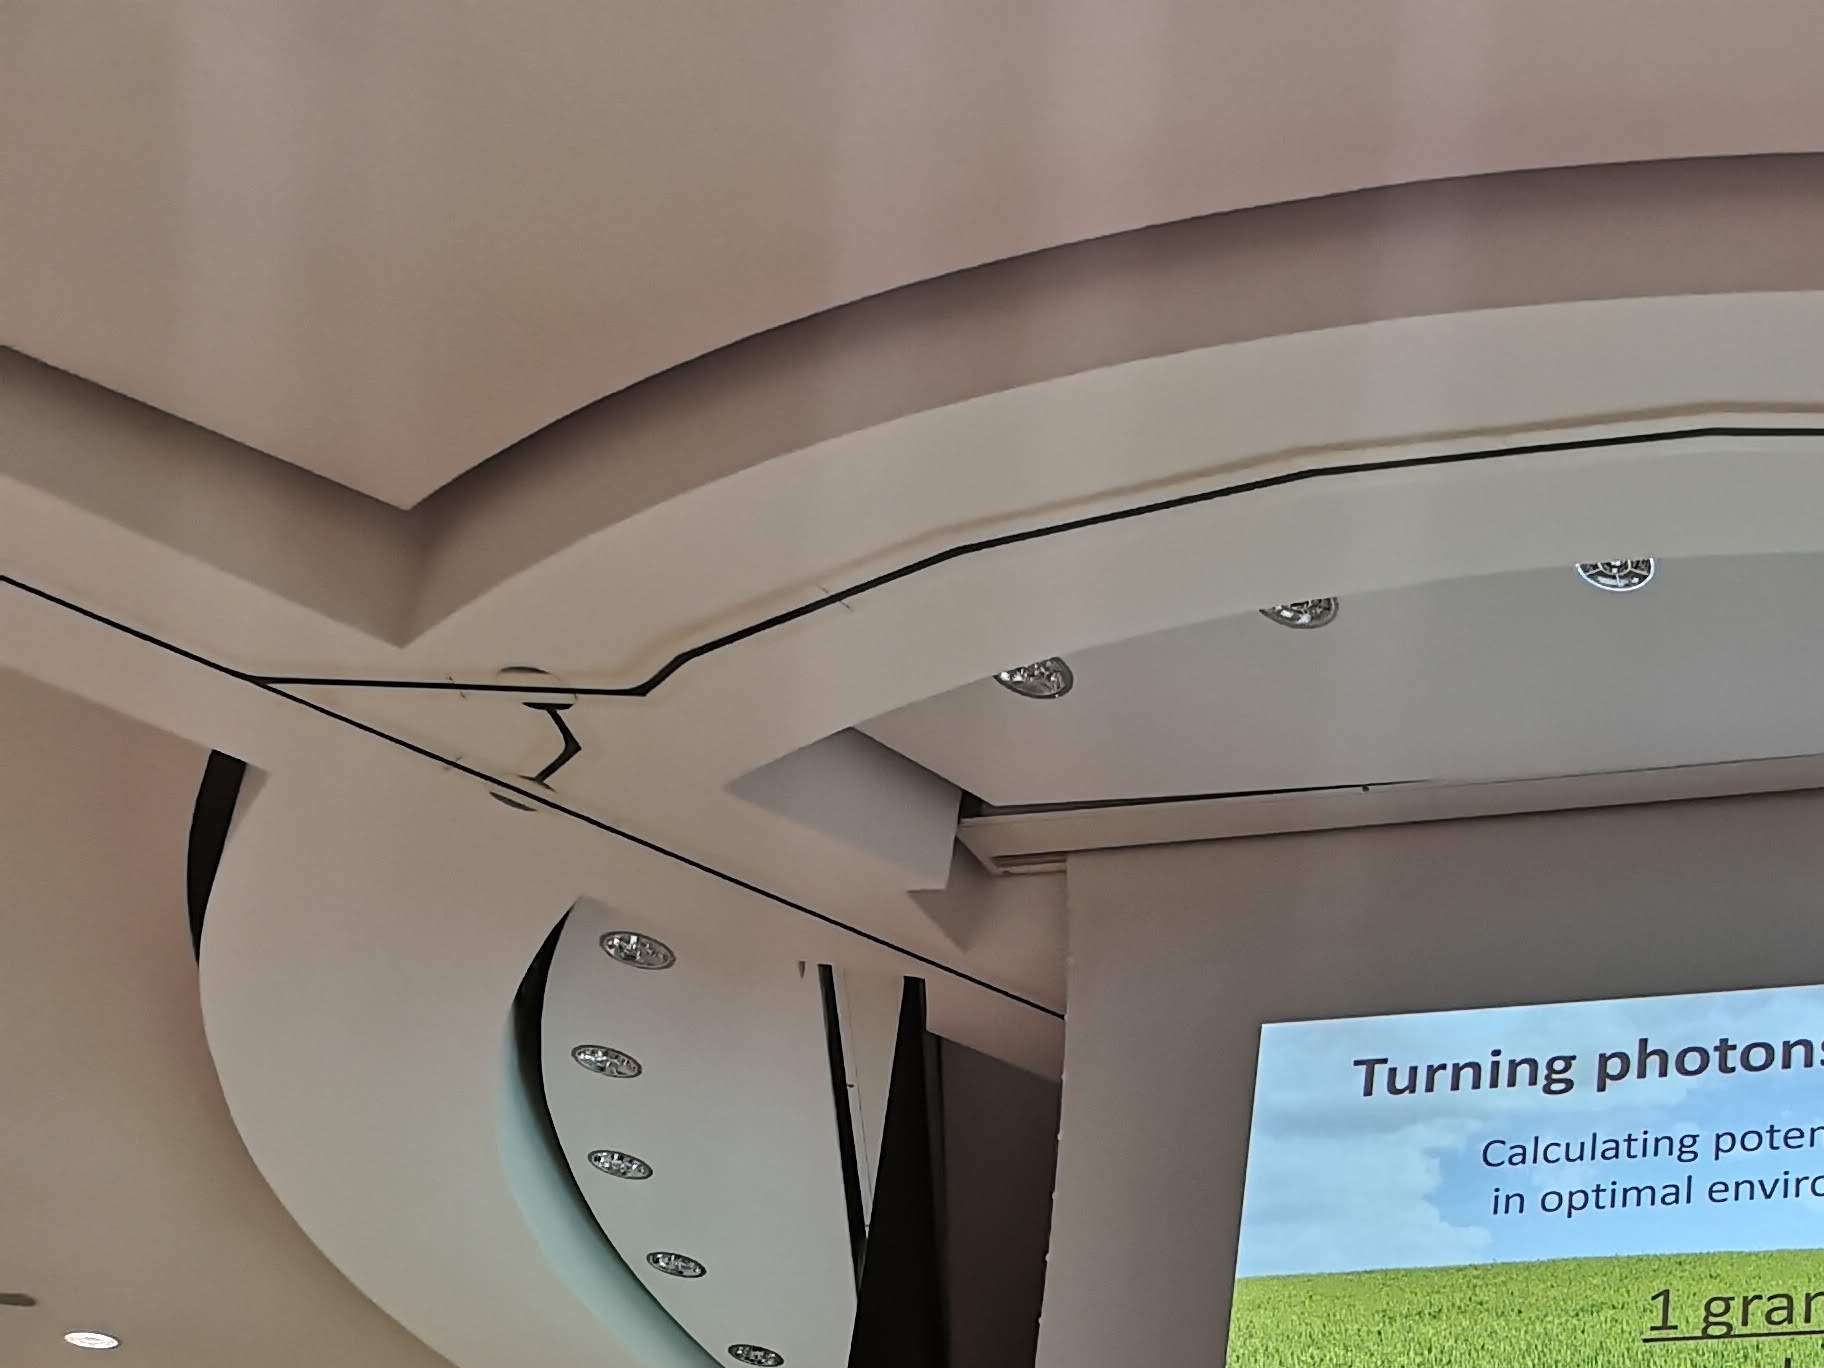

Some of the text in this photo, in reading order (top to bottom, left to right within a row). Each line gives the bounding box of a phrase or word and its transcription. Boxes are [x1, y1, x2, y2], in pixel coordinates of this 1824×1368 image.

[1353, 1048, 1577, 1096] Turning
[1481, 1129, 1700, 1168] Calculating
[1491, 1187, 1525, 1216] in
[1539, 1174, 1693, 1219] optimal
[1649, 1288, 1680, 1332] 1
